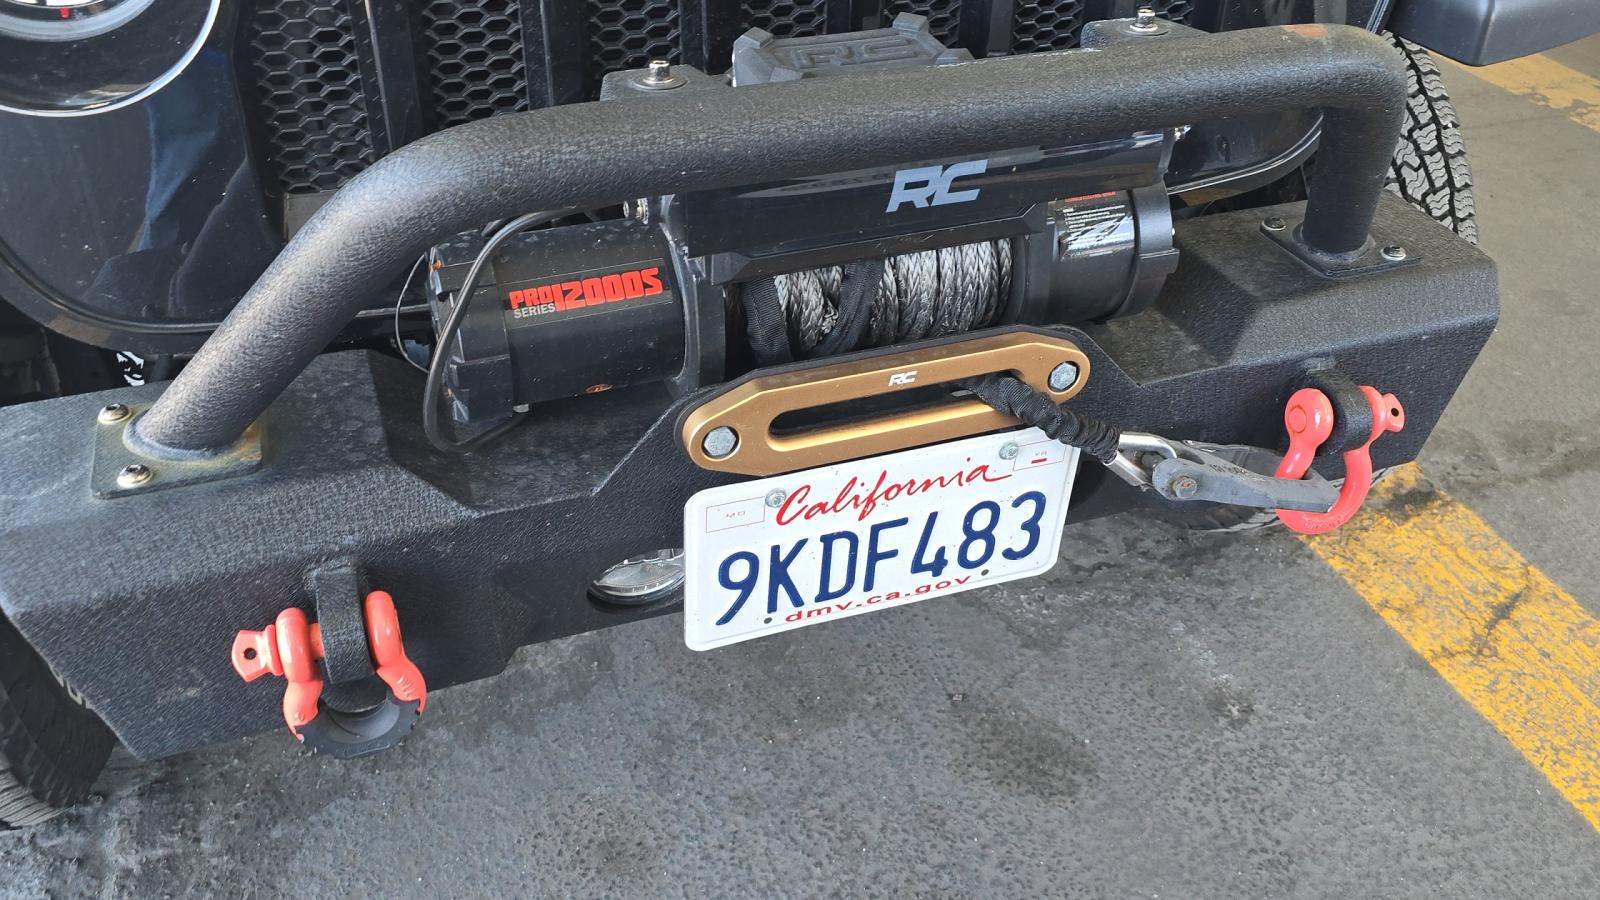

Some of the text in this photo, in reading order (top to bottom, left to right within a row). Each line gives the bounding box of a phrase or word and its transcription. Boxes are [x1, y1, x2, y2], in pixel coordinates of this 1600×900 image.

[885, 159, 989, 213] RC
[513, 302, 555, 319] SERIES
[888, 370, 918, 387] RC
[776, 457, 1013, 527] California
[715, 491, 1047, 627] 9KDF483
[784, 574, 970, 623] dmv.ca.gov
